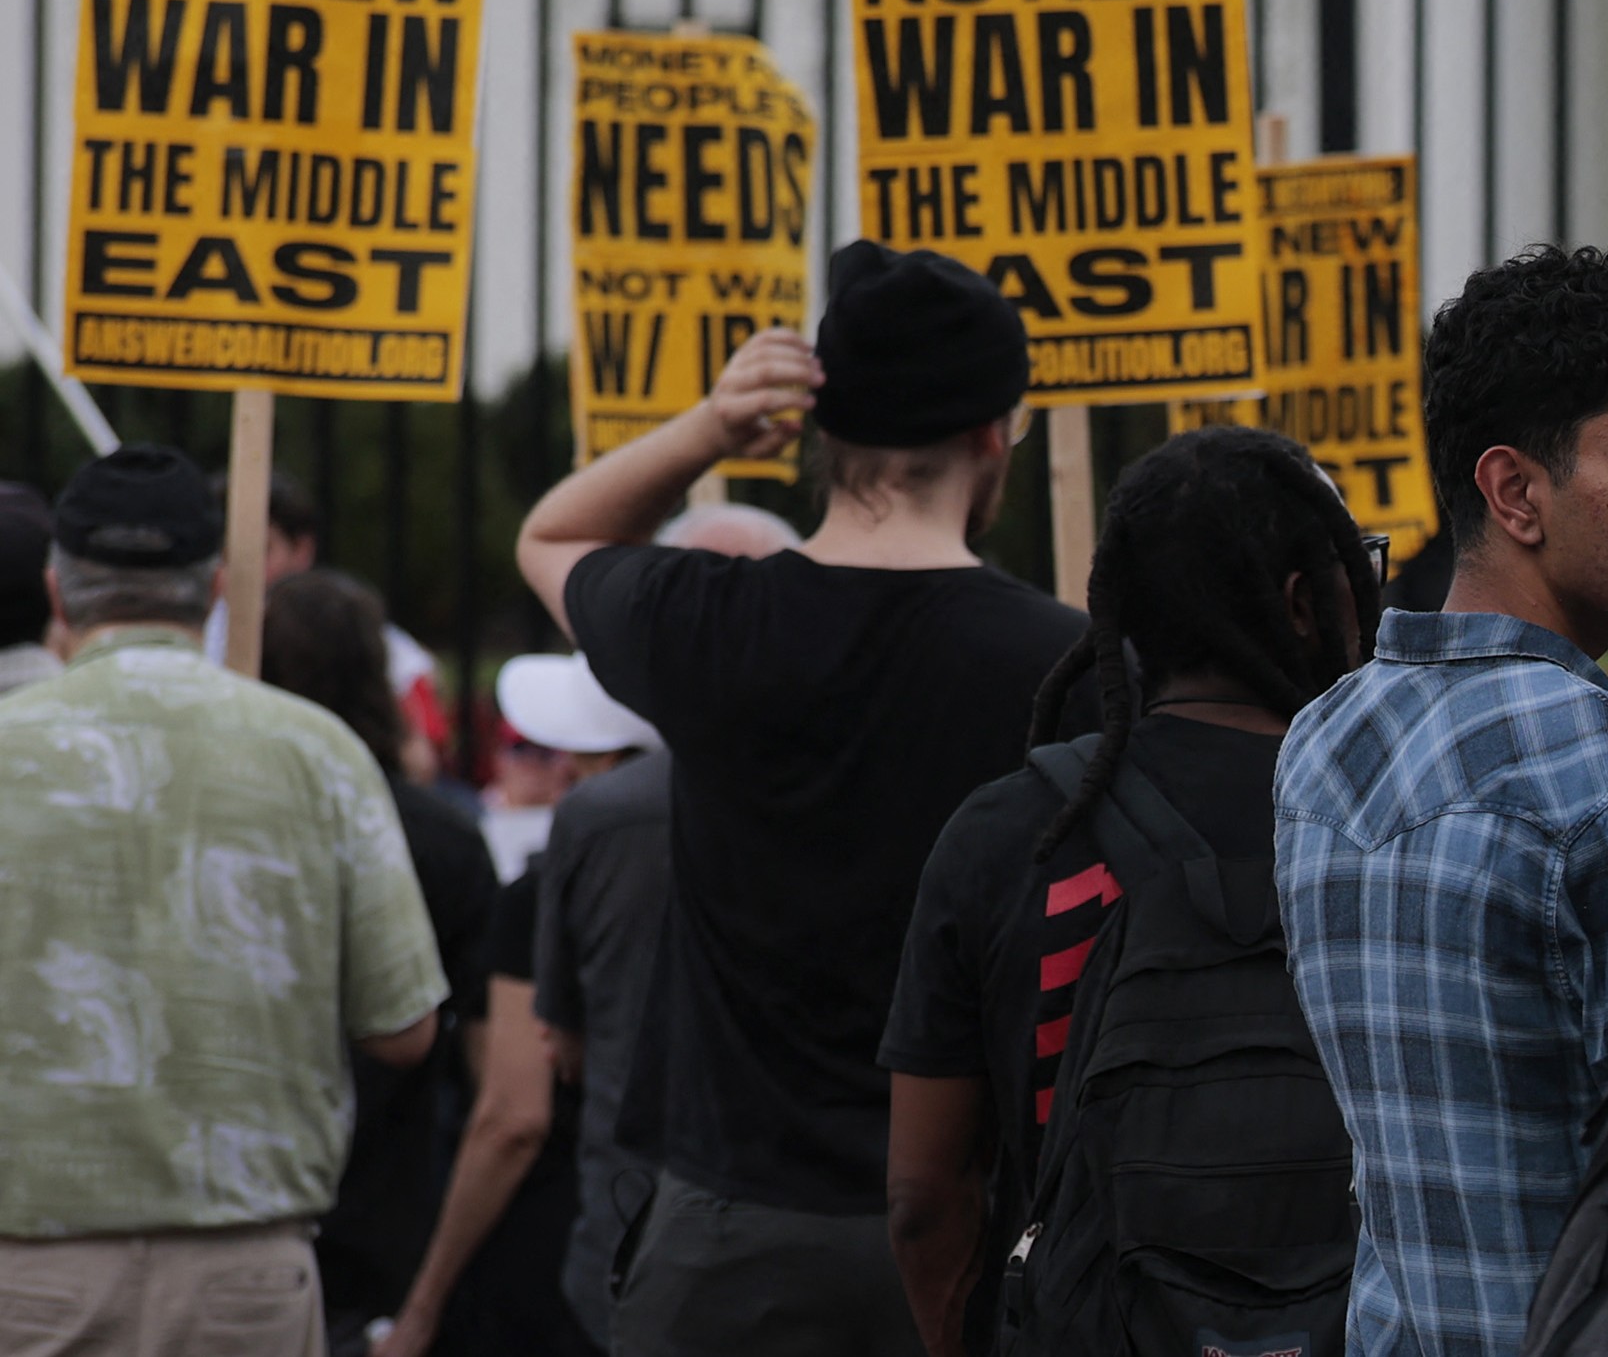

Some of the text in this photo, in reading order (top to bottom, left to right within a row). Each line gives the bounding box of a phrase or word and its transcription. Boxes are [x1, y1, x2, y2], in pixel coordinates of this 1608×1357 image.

[363, 14, 460, 135] IN
[865, 4, 1230, 139] WAR IN
[84, 139, 459, 233] THE MIDDLE
[580, 119, 807, 245] NEEDS
[868, 163, 983, 240] THE
[1008, 151, 1242, 236] MIDDLE
[81, 230, 452, 314] EAST
[1271, 217, 1403, 256] NEW
[578, 268, 688, 302] NOT
[986, 243, 1242, 320] AST
[1341, 260, 1401, 361] IN
[79, 317, 446, 380] ANSWERCOALITION.ORG
[585, 311, 664, 398] W/
